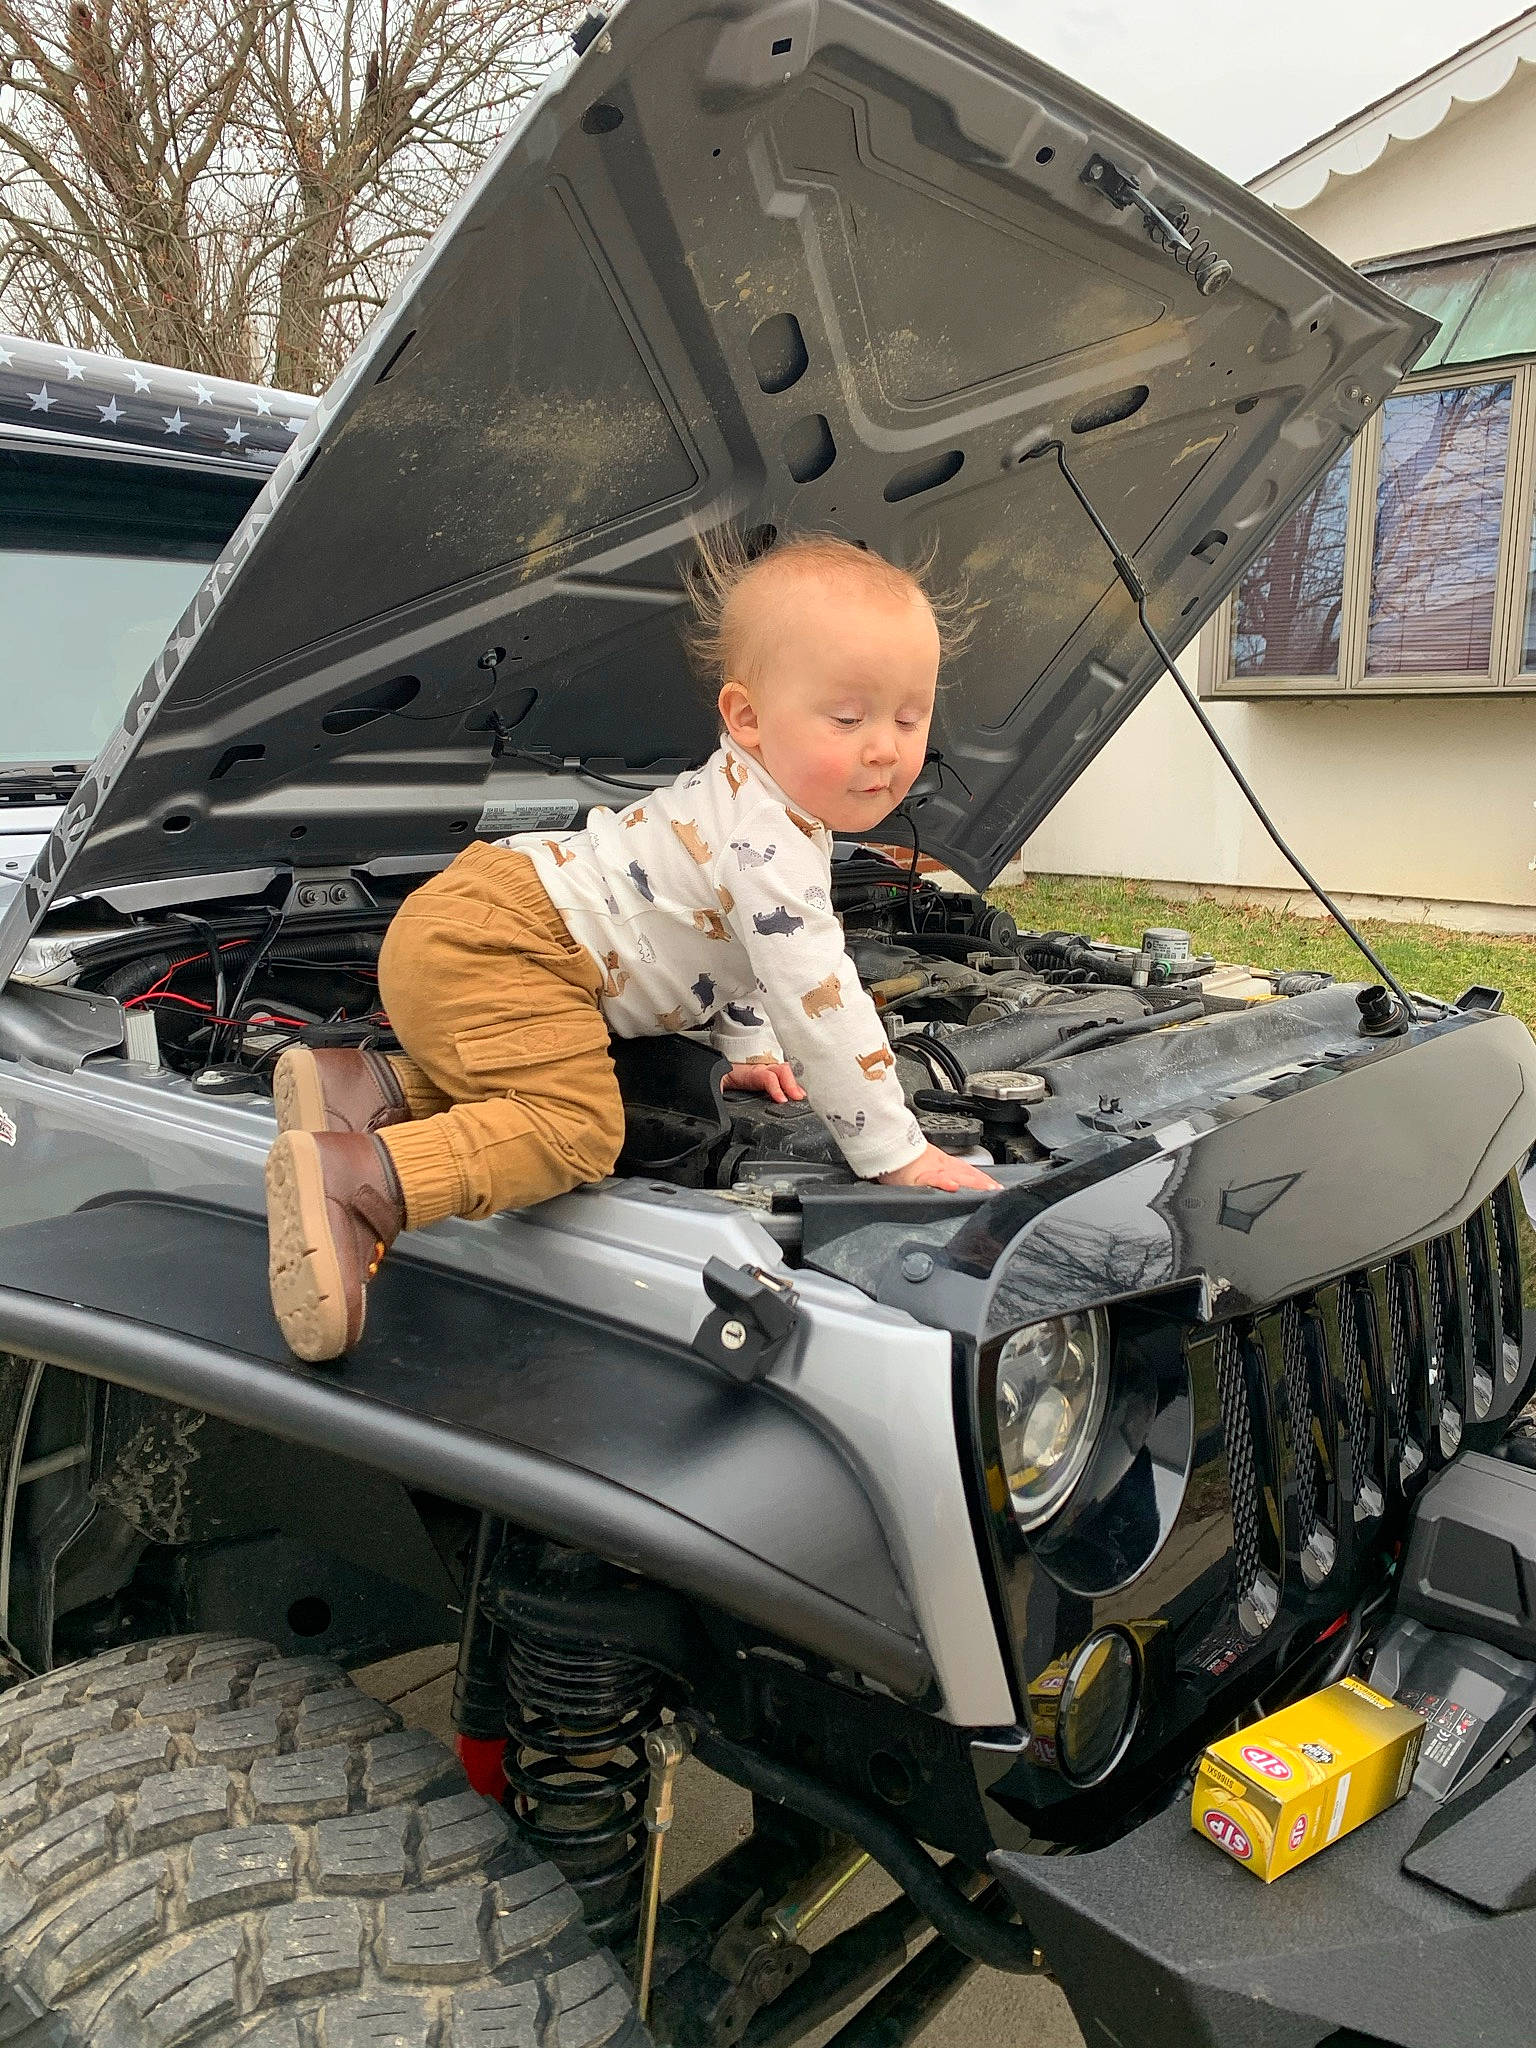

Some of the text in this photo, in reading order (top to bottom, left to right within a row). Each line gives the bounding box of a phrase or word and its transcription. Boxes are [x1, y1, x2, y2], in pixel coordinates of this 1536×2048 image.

[1246, 1750, 1288, 1776] STP
[1209, 1819, 1247, 1852] STP
[1292, 1819, 1305, 1847] STP
